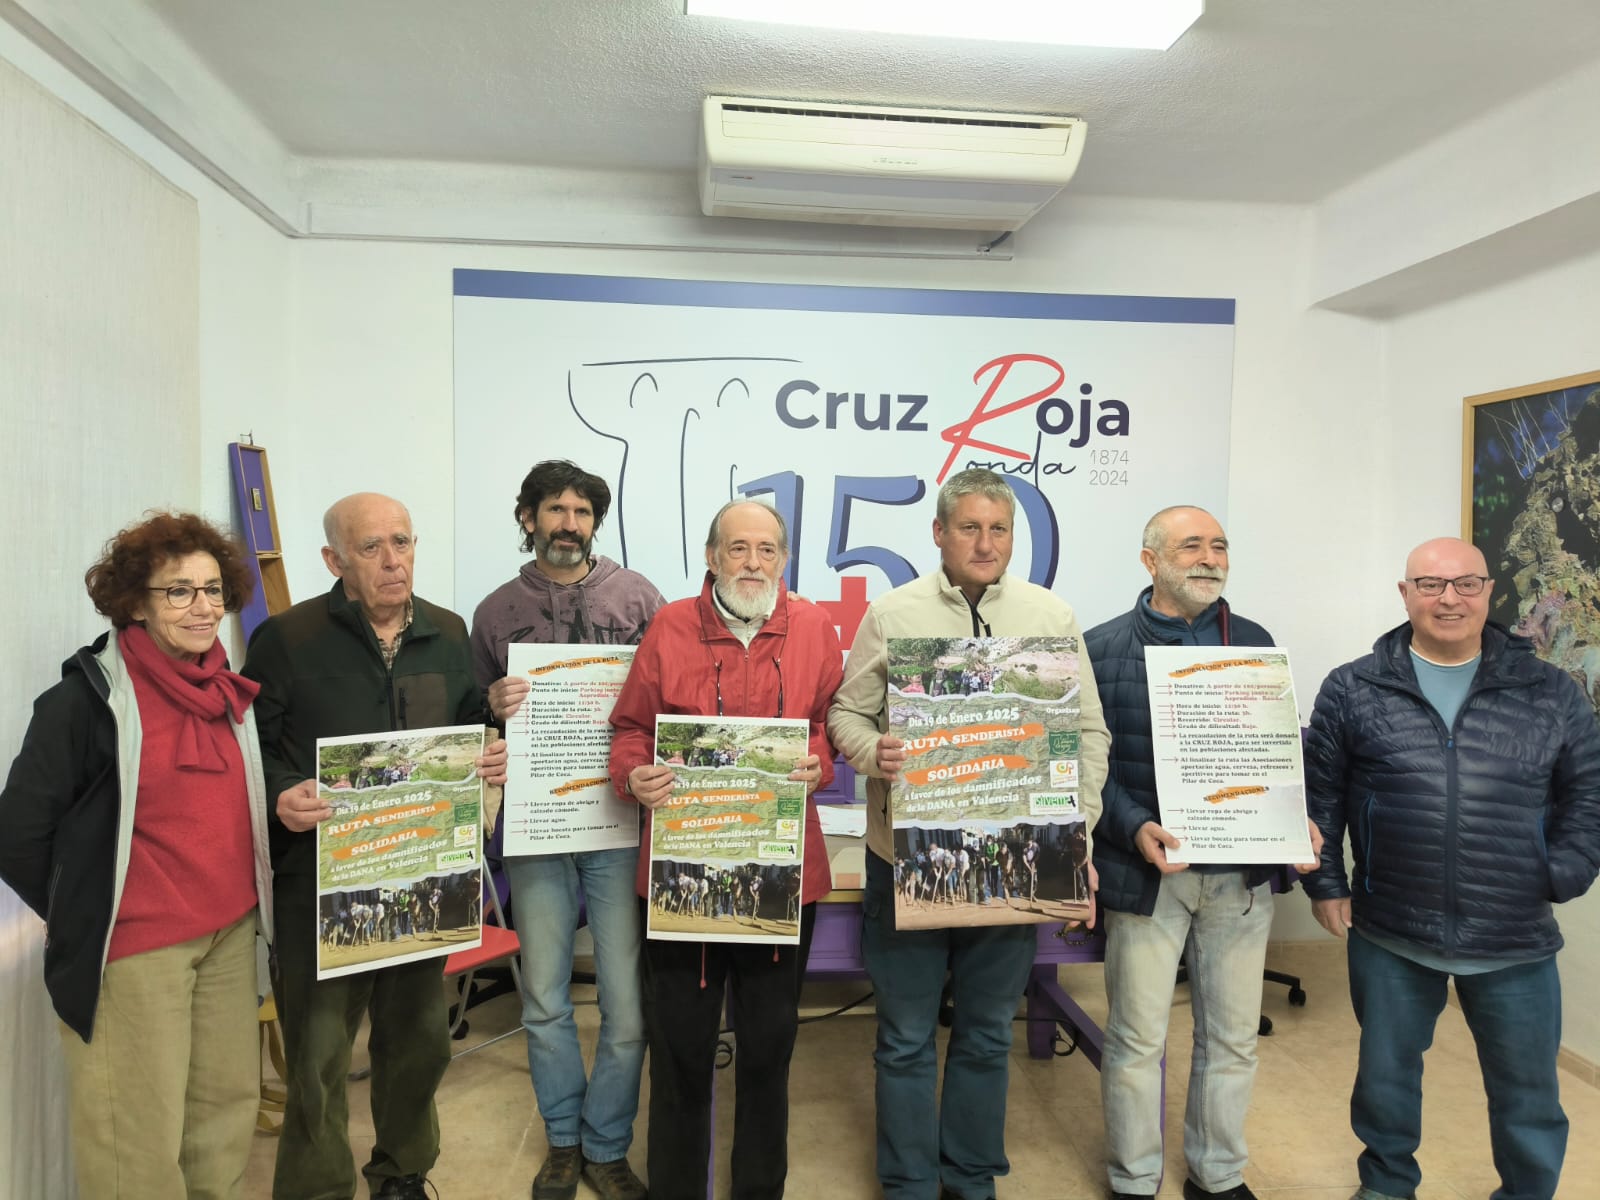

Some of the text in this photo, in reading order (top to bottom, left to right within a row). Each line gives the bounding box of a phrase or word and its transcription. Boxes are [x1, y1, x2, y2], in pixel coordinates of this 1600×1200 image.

[775, 353, 1130, 486] Cruz Roja
[1090, 450, 1129, 465] 1874
[1089, 469, 1128, 486] 2024
[936, 715, 946, 725] de
[950, 712, 983, 724] Enero
[986, 708, 1020, 721] 2025
[901, 727, 1026, 751] RUTA SENDERISTA
[927, 758, 1005, 782] SOLIDARIA
[691, 780, 700, 788] de
[702, 779, 728, 788] Enero
[730, 779, 757, 788] 2025
[910, 790, 933, 800] favor
[935, 787, 946, 796] de
[948, 785, 961, 794] los
[963, 775, 1042, 793] damnificados
[360, 802, 370, 810] de
[372, 798, 400, 809] Enero
[403, 791, 432, 802] 2025
[702, 794, 760, 803] SENDERISTA
[927, 800, 956, 811] DANA
[958, 798, 970, 807] en
[972, 793, 1020, 806] Valencia
[328, 819, 370, 836] RUTA
[373, 806, 435, 824] SENDERISTA
[681, 815, 742, 829] SOLIDARIA
[351, 830, 418, 856] SOLIDARIA
[707, 828, 770, 840] damnificados
[381, 839, 448, 860] damnificados
[714, 840, 750, 848] Valencia
[350, 867, 374, 878] DANA
[389, 855, 428, 870] Valencia
